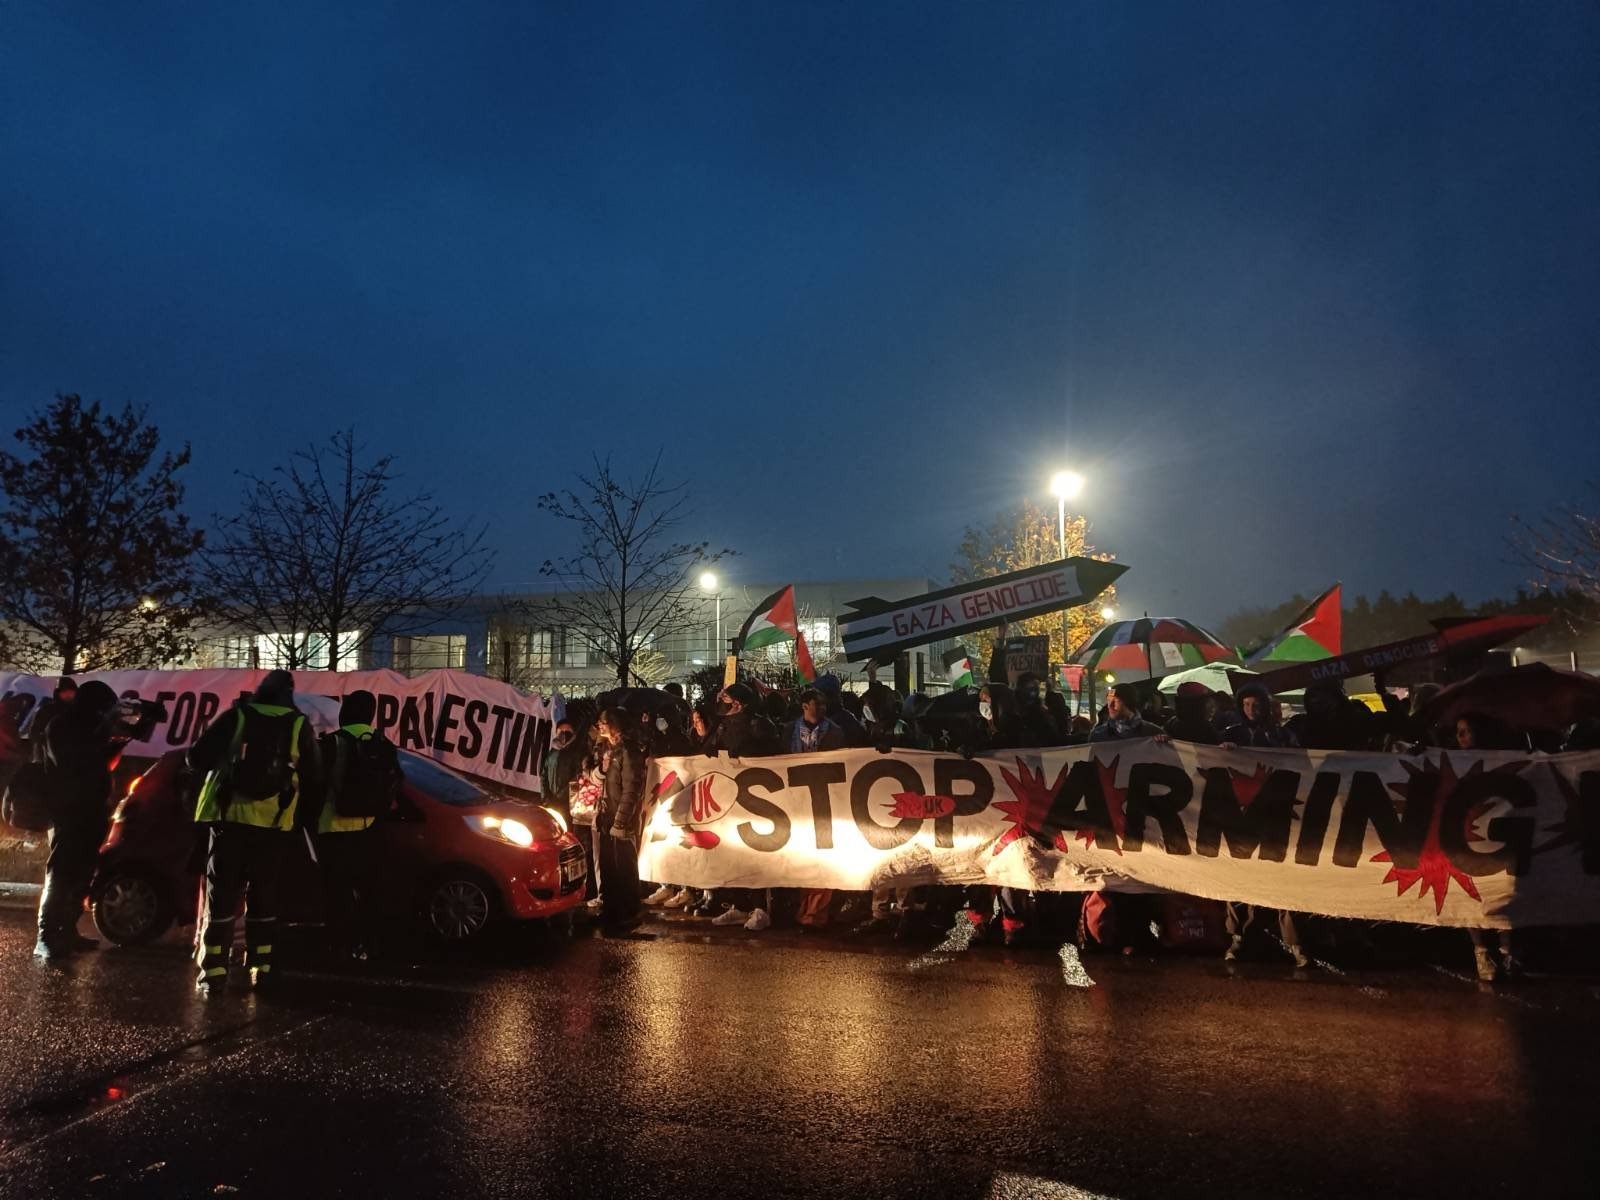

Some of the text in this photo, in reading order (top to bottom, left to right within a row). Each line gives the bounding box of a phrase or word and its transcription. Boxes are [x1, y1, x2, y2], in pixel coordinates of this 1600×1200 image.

[893, 574, 1068, 637] GAZA GENOCIDE
[1311, 659, 1351, 680] GAZA
[376, 692, 553, 777] PALESTIN
[691, 774, 722, 822] UK
[737, 759, 994, 851] STOP
[1039, 760, 1537, 877] ARMING
[925, 798, 944, 813] UK
